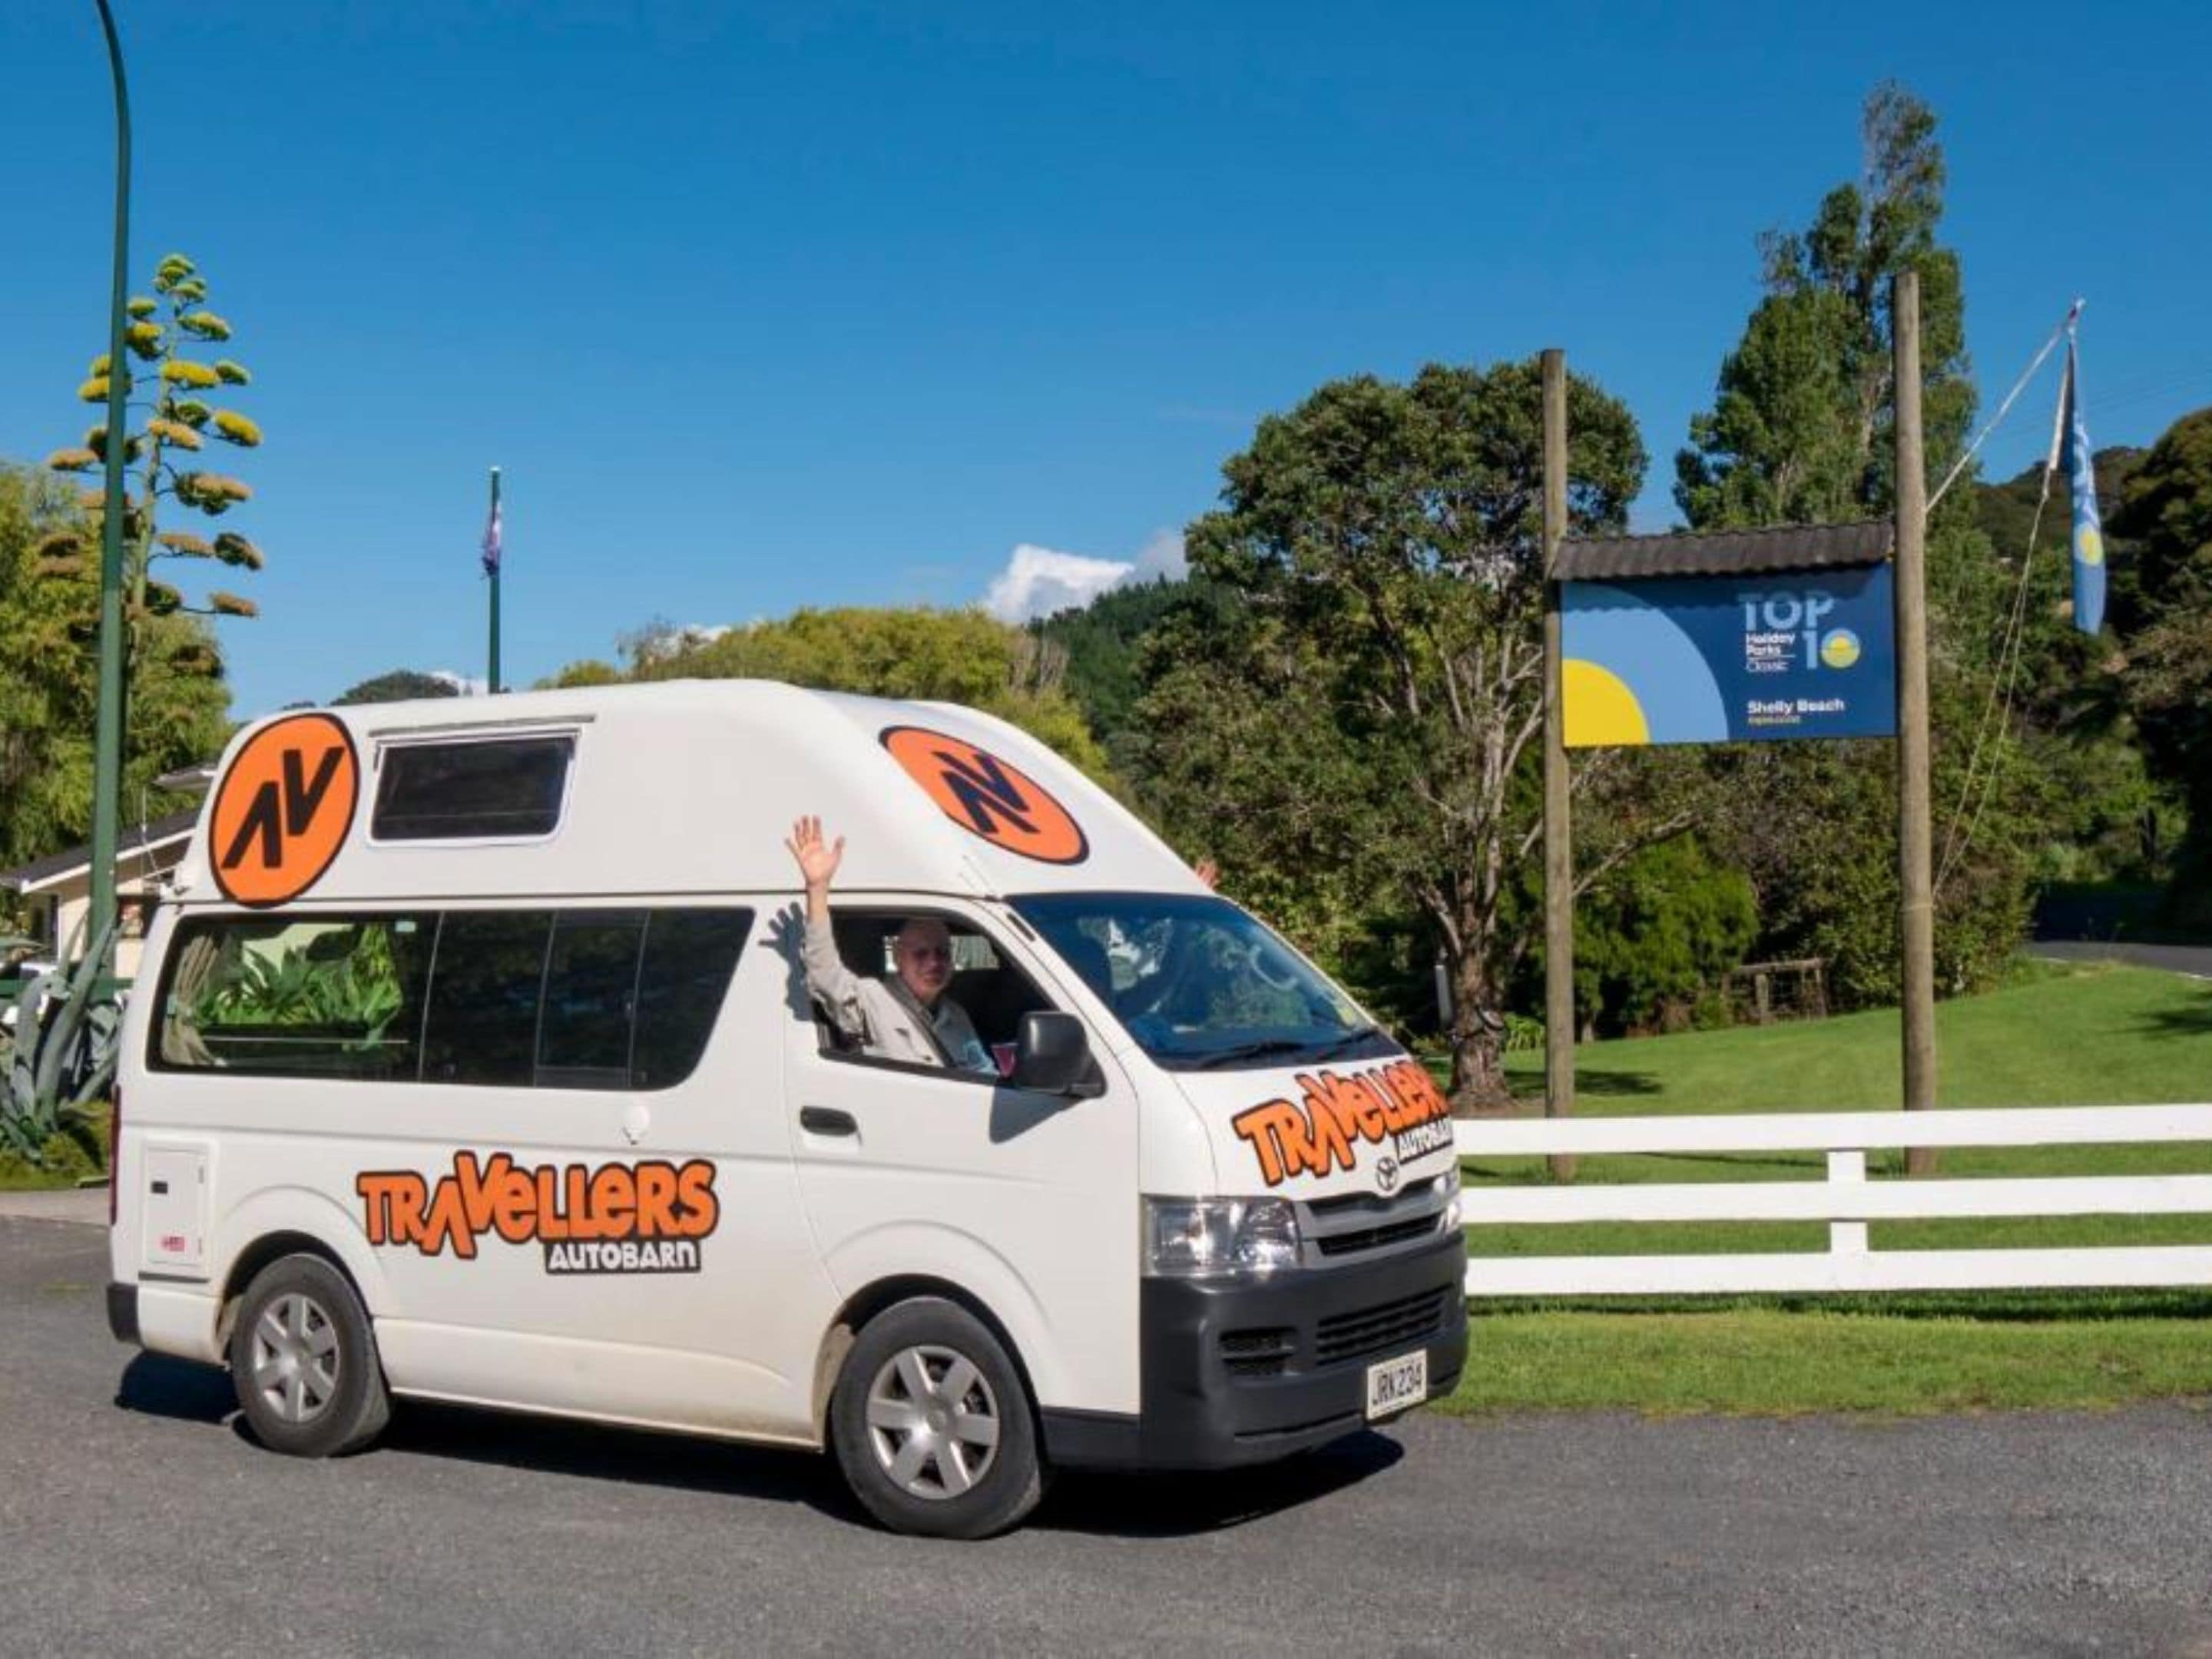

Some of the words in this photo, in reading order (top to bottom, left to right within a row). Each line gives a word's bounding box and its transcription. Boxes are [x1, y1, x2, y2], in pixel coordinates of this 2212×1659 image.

[1738, 591, 1834, 631] TOP
[1746, 632, 1795, 644] Holiday
[1746, 645, 1781, 655] Parks
[1748, 700, 1793, 717] Shelly
[1797, 699, 1845, 712] Beach
[356, 1151, 720, 1260] TRAVELLERS
[548, 1242, 697, 1270] AUTOBARN
